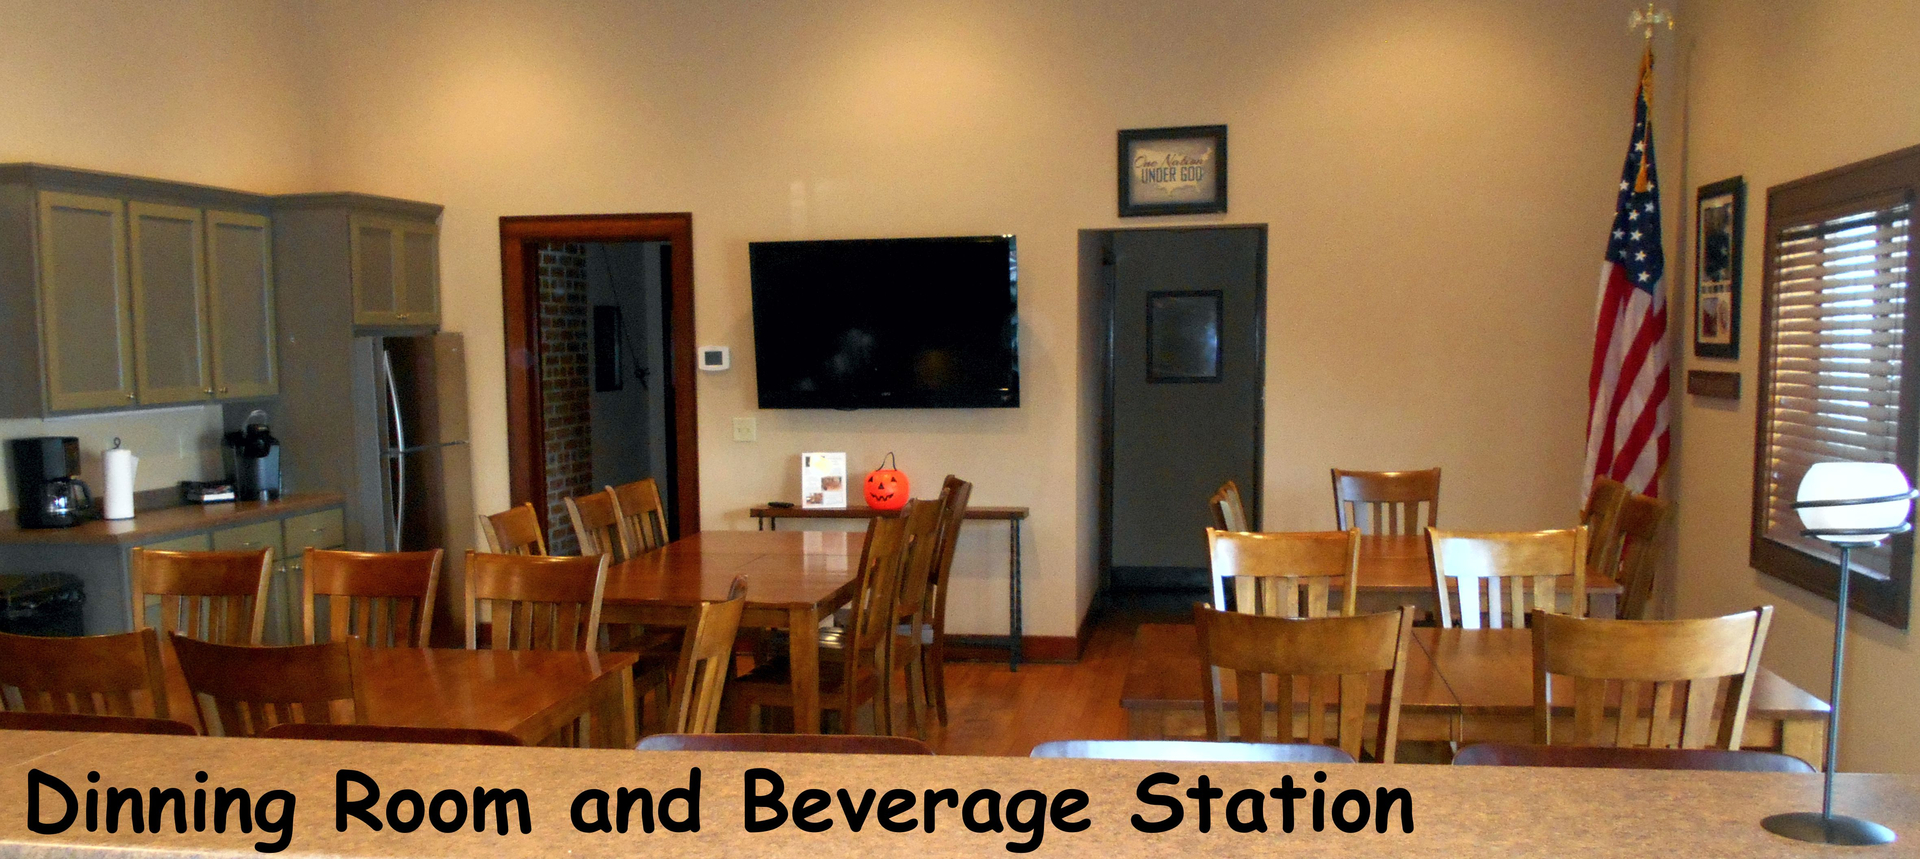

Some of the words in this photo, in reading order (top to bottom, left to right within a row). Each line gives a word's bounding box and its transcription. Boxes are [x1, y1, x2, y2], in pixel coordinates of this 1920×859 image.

[1134, 155, 1158, 168] One
[1161, 153, 1203, 167] Nation
[1141, 167, 1176, 184] UNDER
[1180, 165, 1203, 182] GOD
